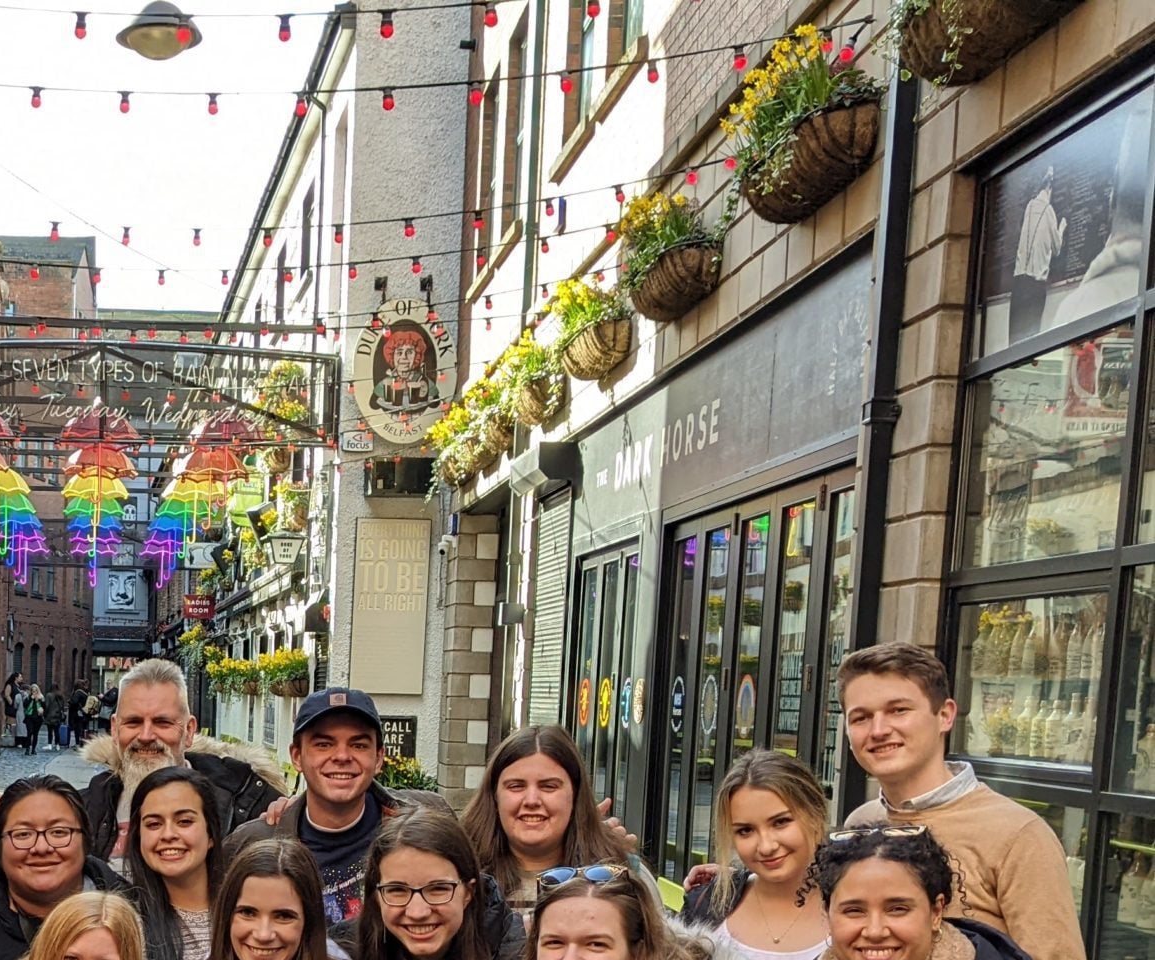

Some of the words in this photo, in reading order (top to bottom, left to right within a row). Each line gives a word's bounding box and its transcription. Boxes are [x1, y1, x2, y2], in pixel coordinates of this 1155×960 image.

[395, 301, 418, 316] OF
[427, 314, 454, 357] ORK
[12, 358, 69, 382] SEVEN
[78, 359, 135, 383] TYPES
[141, 361, 165, 383] OF
[172, 364, 216, 389] RAIN
[383, 423, 424, 438] BELFAST
[346, 439, 370, 450] focus
[596, 468, 608, 488] THE
[614, 433, 654, 492] DARK
[659, 398, 721, 468] HORSE
[359, 539, 375, 560] IS
[378, 539, 426, 560] GOING
[358, 561, 389, 592] TO
[396, 561, 426, 593] BE
[357, 593, 382, 610] ALL
[384, 593, 425, 611] RIGHT
[384, 721, 412, 733] CALL
